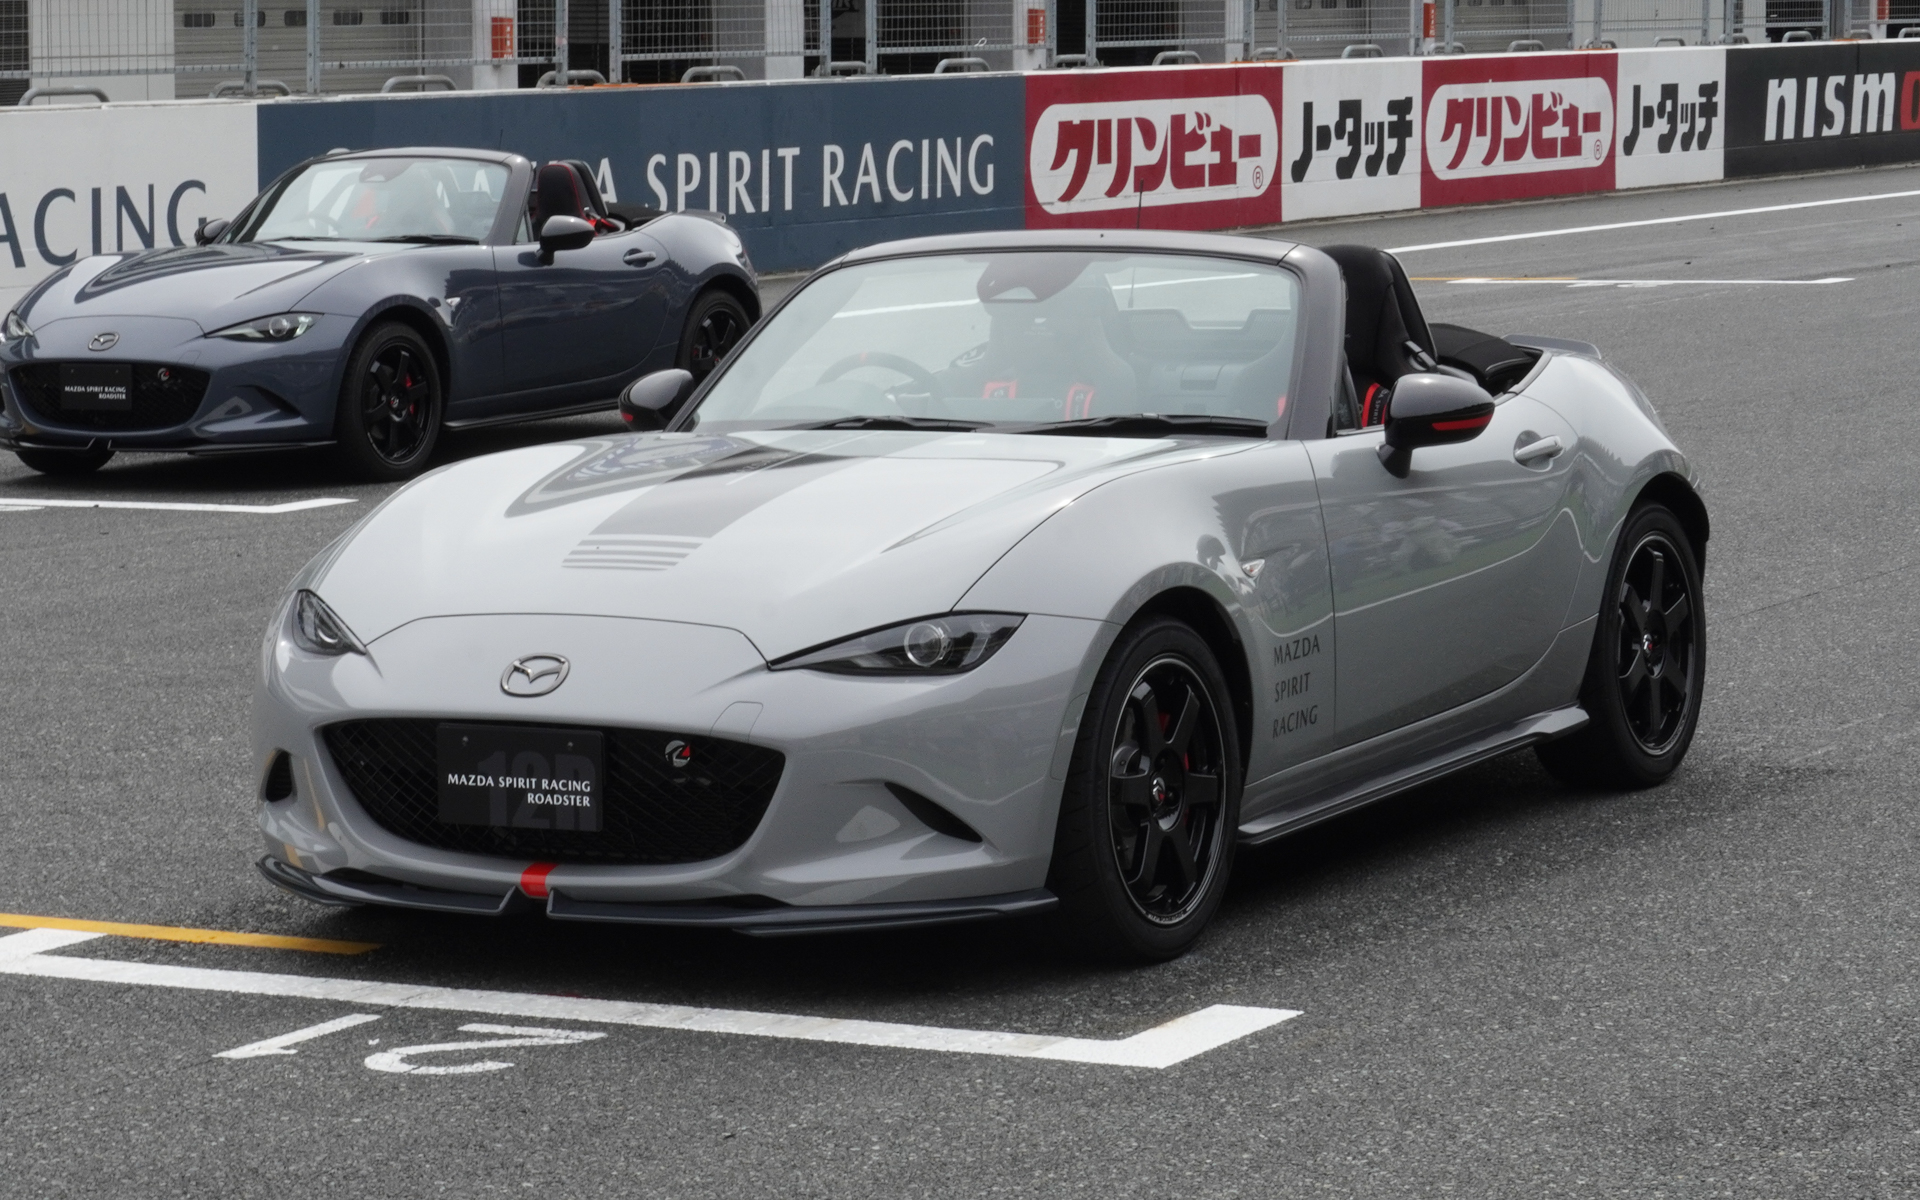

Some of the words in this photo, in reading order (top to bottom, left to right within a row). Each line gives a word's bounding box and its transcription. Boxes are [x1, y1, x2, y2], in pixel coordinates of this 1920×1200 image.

[1050, 91, 1261, 202] クリンビュー
[1291, 96, 1413, 183] ノータッチ
[1440, 91, 1601, 170] クリンビュー
[1623, 81, 1718, 156] ノータッチ
[647, 146, 800, 214] SPIRIT
[823, 134, 994, 207] RACING
[0, 179, 207, 269] ACING
[1274, 634, 1320, 666] MAZDA
[1275, 672, 1311, 702] SPIRIT
[1272, 705, 1318, 738] RACING
[447, 773, 495, 787] MAZDA
[498, 776, 537, 790] SPIRIT
[541, 778, 591, 793] RACING
[527, 792, 591, 807] ROADSTER
